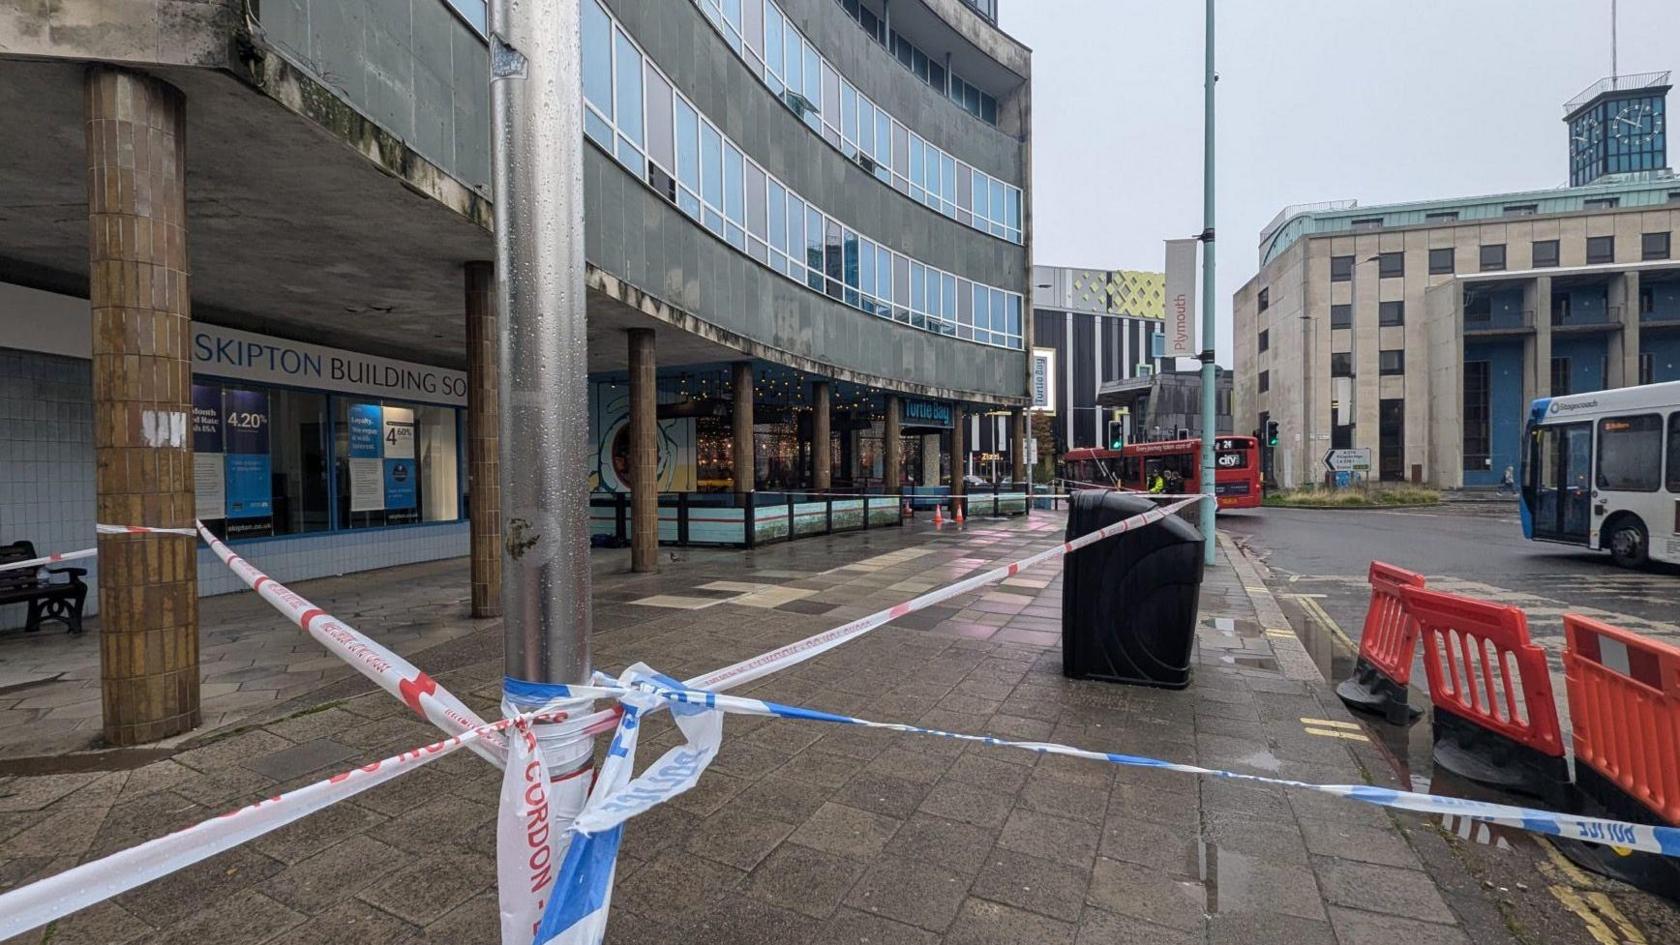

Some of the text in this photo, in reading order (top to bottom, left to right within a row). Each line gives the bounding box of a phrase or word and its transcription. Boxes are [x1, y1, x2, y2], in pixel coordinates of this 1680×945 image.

[1173, 293, 1188, 351] Plymouth
[194, 333, 322, 378] SKIPTON
[330, 357, 437, 394] BUILDING
[1035, 358, 1046, 404] Turtle Bay
[227, 411, 268, 429] 4.20%
[906, 400, 949, 425] Turtle Bay
[1559, 400, 1598, 412] Stagecoach
[524, 760, 552, 894] CORDON
[1575, 821, 1636, 845] POLICE
